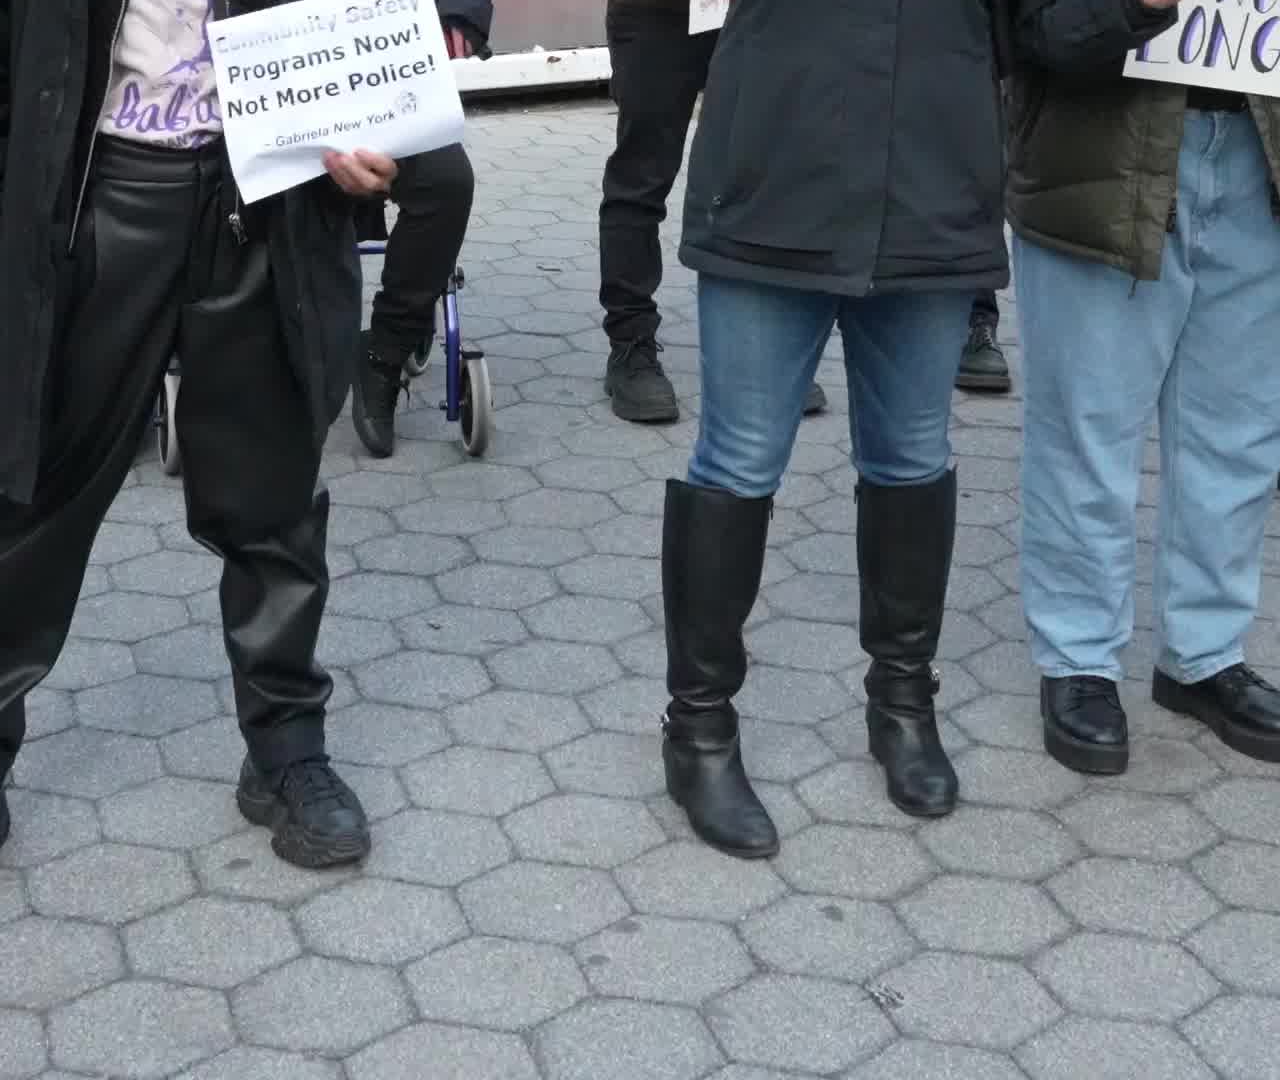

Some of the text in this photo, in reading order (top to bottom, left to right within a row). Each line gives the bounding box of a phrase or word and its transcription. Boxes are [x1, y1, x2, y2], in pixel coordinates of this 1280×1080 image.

[227, 23, 422, 85] Programs Now!
[227, 54, 437, 119] Not More Police!
[275, 126, 330, 148] Gabriela
[333, 120, 363, 133] New
[366, 110, 396, 126] York
